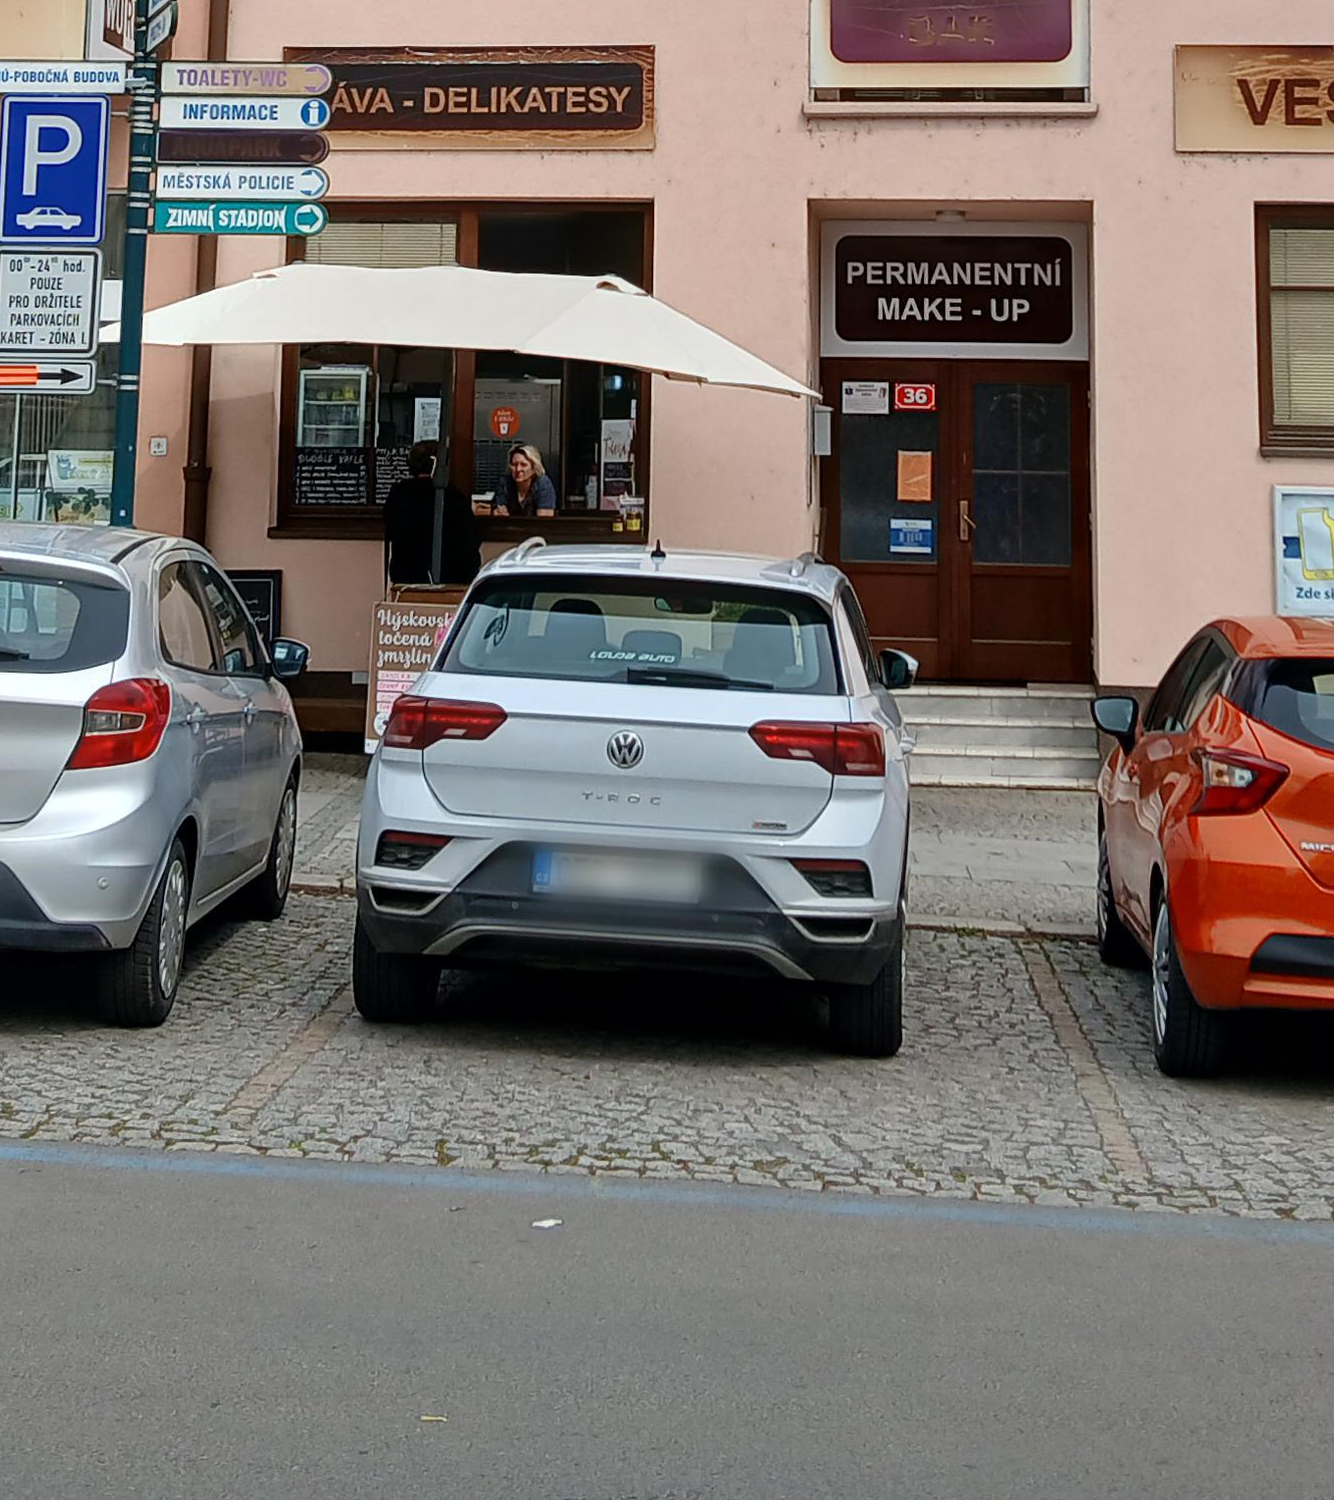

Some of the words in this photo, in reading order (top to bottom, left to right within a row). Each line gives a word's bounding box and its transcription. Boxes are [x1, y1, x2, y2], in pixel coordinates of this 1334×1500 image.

[73, 71, 121, 84] BUDOVA
[176, 68, 287, 88] TOALETY-WC
[331, 81, 395, 114] ÁVA
[424, 85, 632, 115] DELIKATESY
[182, 102, 279, 121] INFORMACE
[22, 114, 84, 197] P
[162, 172, 232, 190] MĚSTSKÁ
[238, 175, 295, 191] POLICIE
[166, 204, 217, 231] ZIMNÍ
[218, 205, 287, 233] STADION
[63, 259, 85, 272] hod.
[846, 258, 1062, 286] PERMANENTNÍ
[30, 277, 63, 290] POUZE
[8, 295, 29, 308] PRO
[34, 292, 82, 309] DRŽITELE
[877, 297, 963, 322] MAKE
[990, 298, 1030, 322] UP
[10, 309, 80, 327] PARKOVACÍCH
[0, 331, 35, 345] KARET
[48, 328, 76, 345] ZÓNA
[903, 388, 928, 405] 36
[1295, 586, 1321, 599] Zde
[378, 630, 433, 647] točená
[376, 647, 432, 669] zmrzlin
